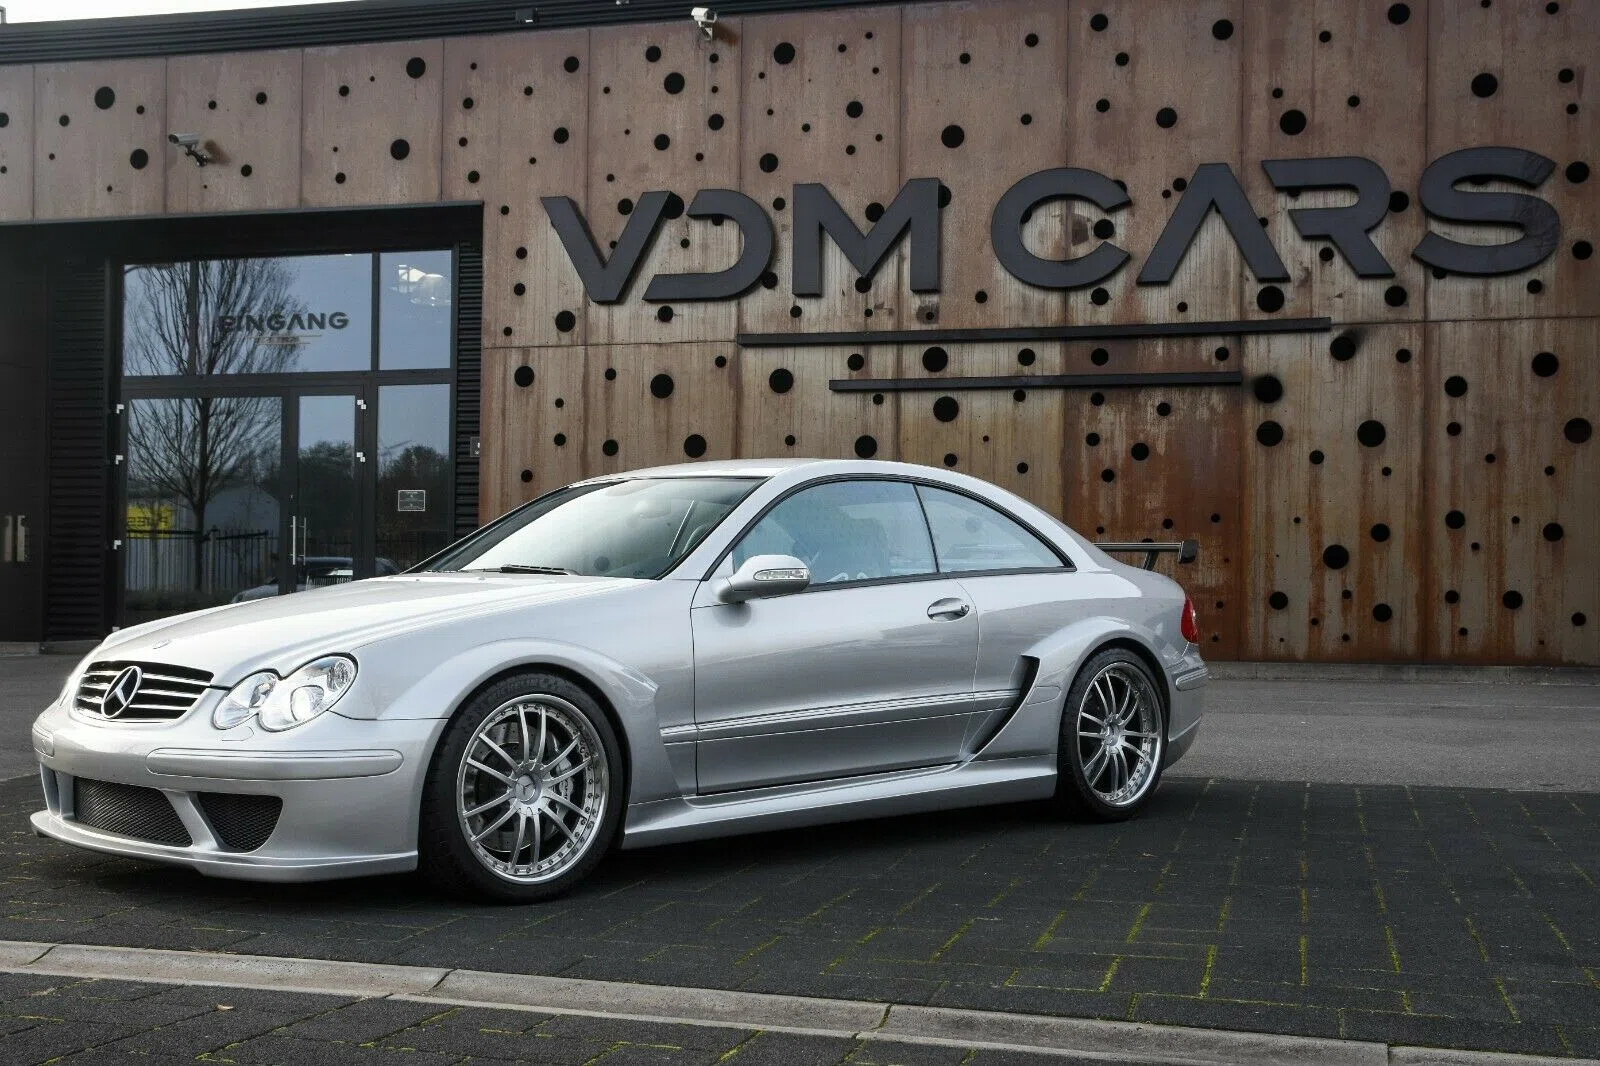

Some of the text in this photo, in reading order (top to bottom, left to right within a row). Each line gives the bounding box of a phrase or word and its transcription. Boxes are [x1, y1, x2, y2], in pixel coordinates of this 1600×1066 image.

[540, 146, 1560, 303] VDM CARS
[219, 311, 349, 332] EINGANG
